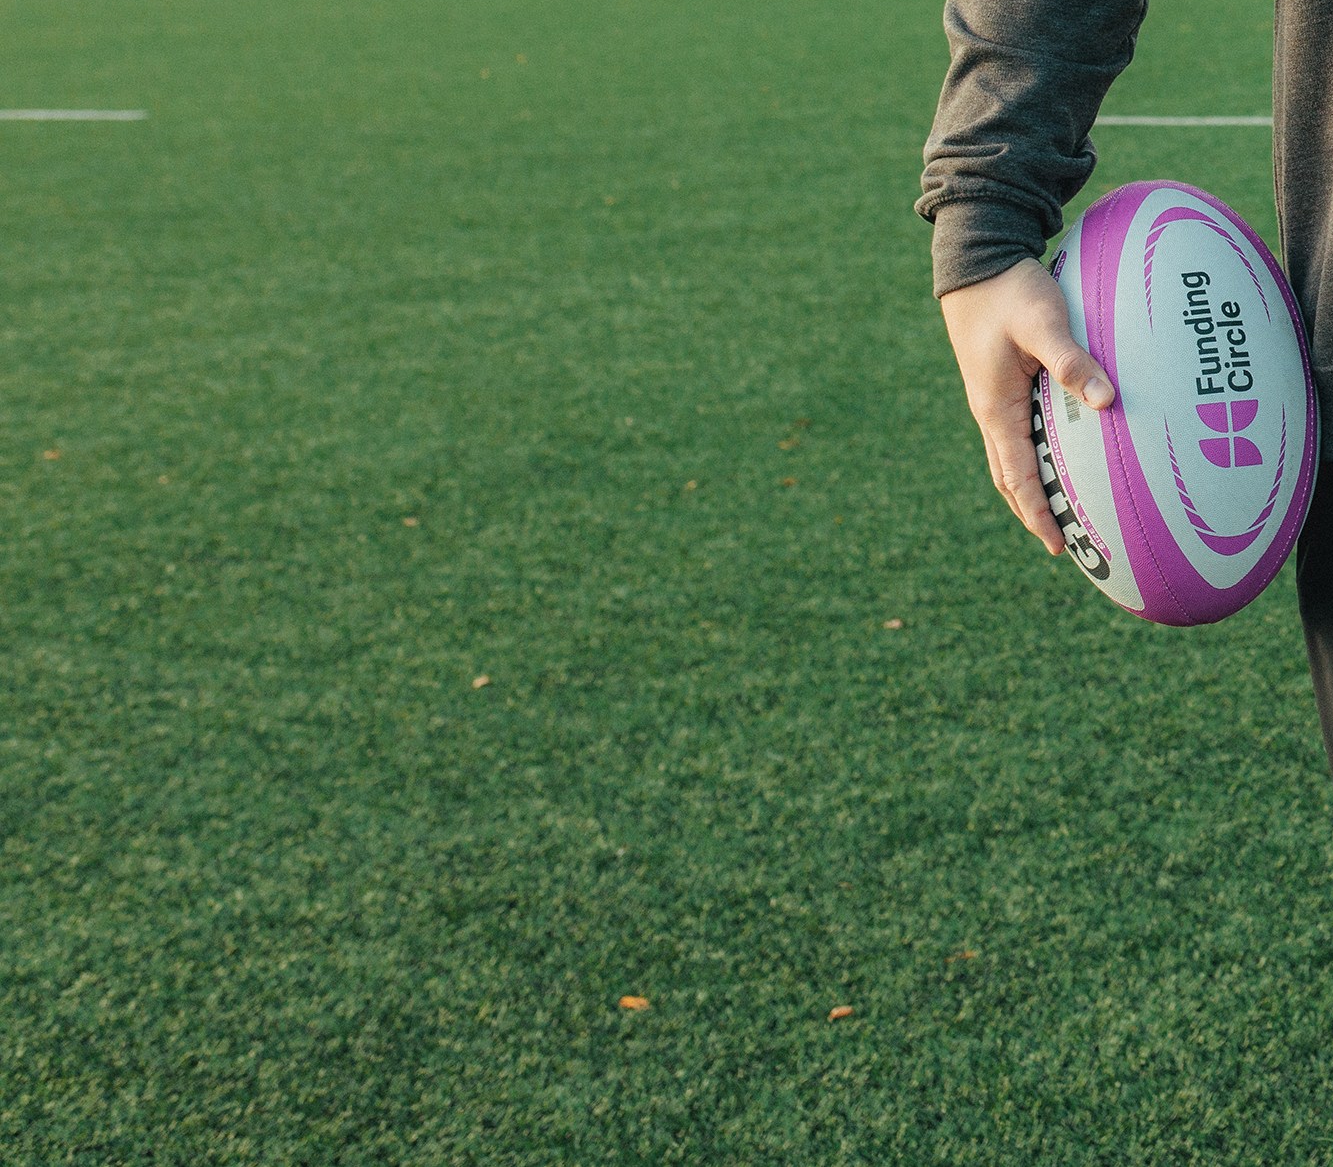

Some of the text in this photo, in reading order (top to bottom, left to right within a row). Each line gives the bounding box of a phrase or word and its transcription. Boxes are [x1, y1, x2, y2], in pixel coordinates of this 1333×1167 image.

[1181, 271, 1225, 395] Funding
[1216, 300, 1254, 392] Circle
[1042, 370, 1067, 476] OFFICIAL REPLICA
